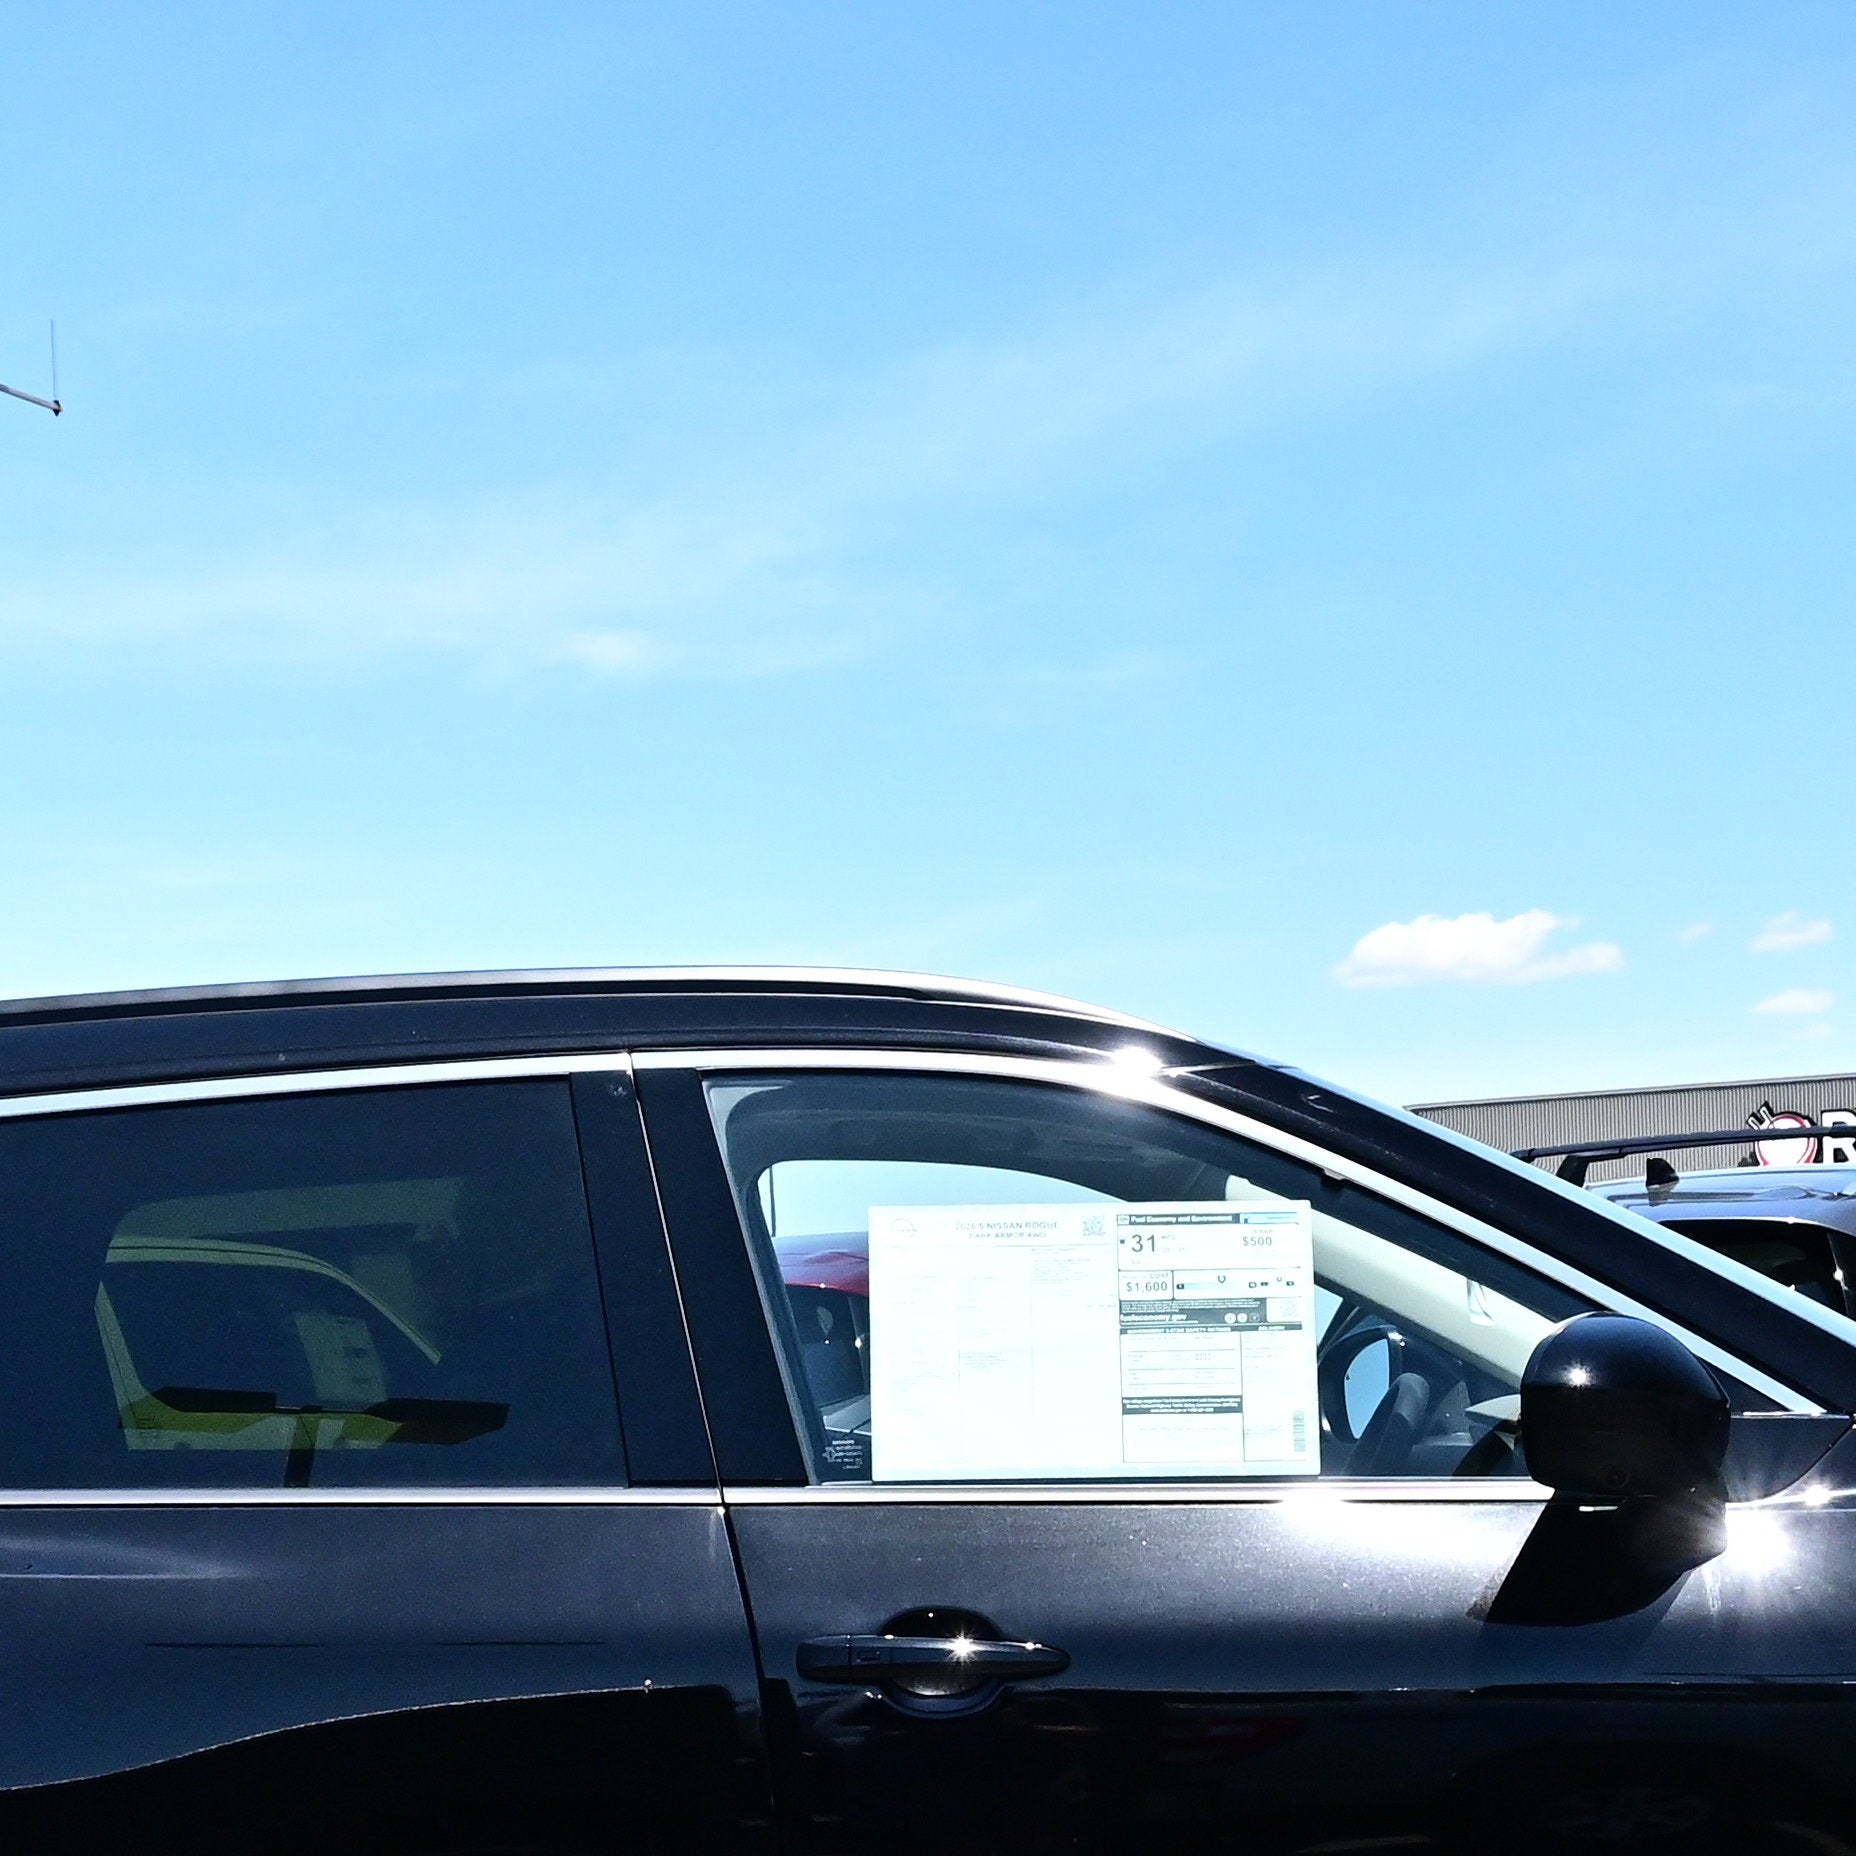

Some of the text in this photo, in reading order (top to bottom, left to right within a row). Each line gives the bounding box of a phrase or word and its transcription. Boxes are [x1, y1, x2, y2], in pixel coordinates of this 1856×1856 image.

[987, 1221, 1023, 1230] NISSAN
[1131, 1233, 1156, 1253] 31
[1242, 1235, 1273, 1247] $500
[1126, 1281, 1168, 1294] $1,600
